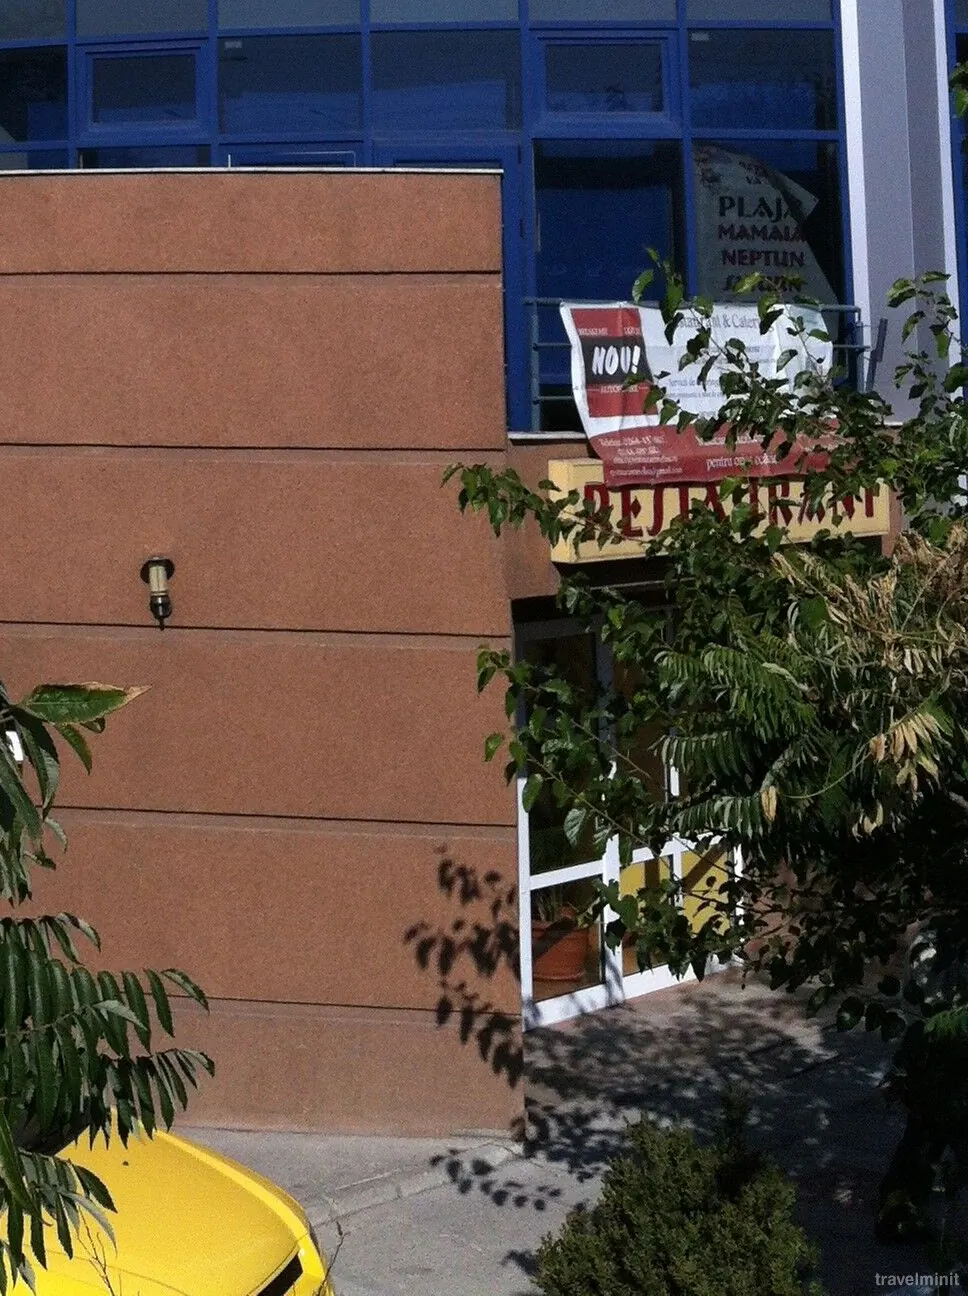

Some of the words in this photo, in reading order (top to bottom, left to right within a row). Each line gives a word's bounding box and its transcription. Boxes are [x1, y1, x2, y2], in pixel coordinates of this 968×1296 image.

[719, 195, 792, 223] PLAJ
[721, 249, 806, 268] NEPTUN
[592, 345, 641, 376] NOU!
